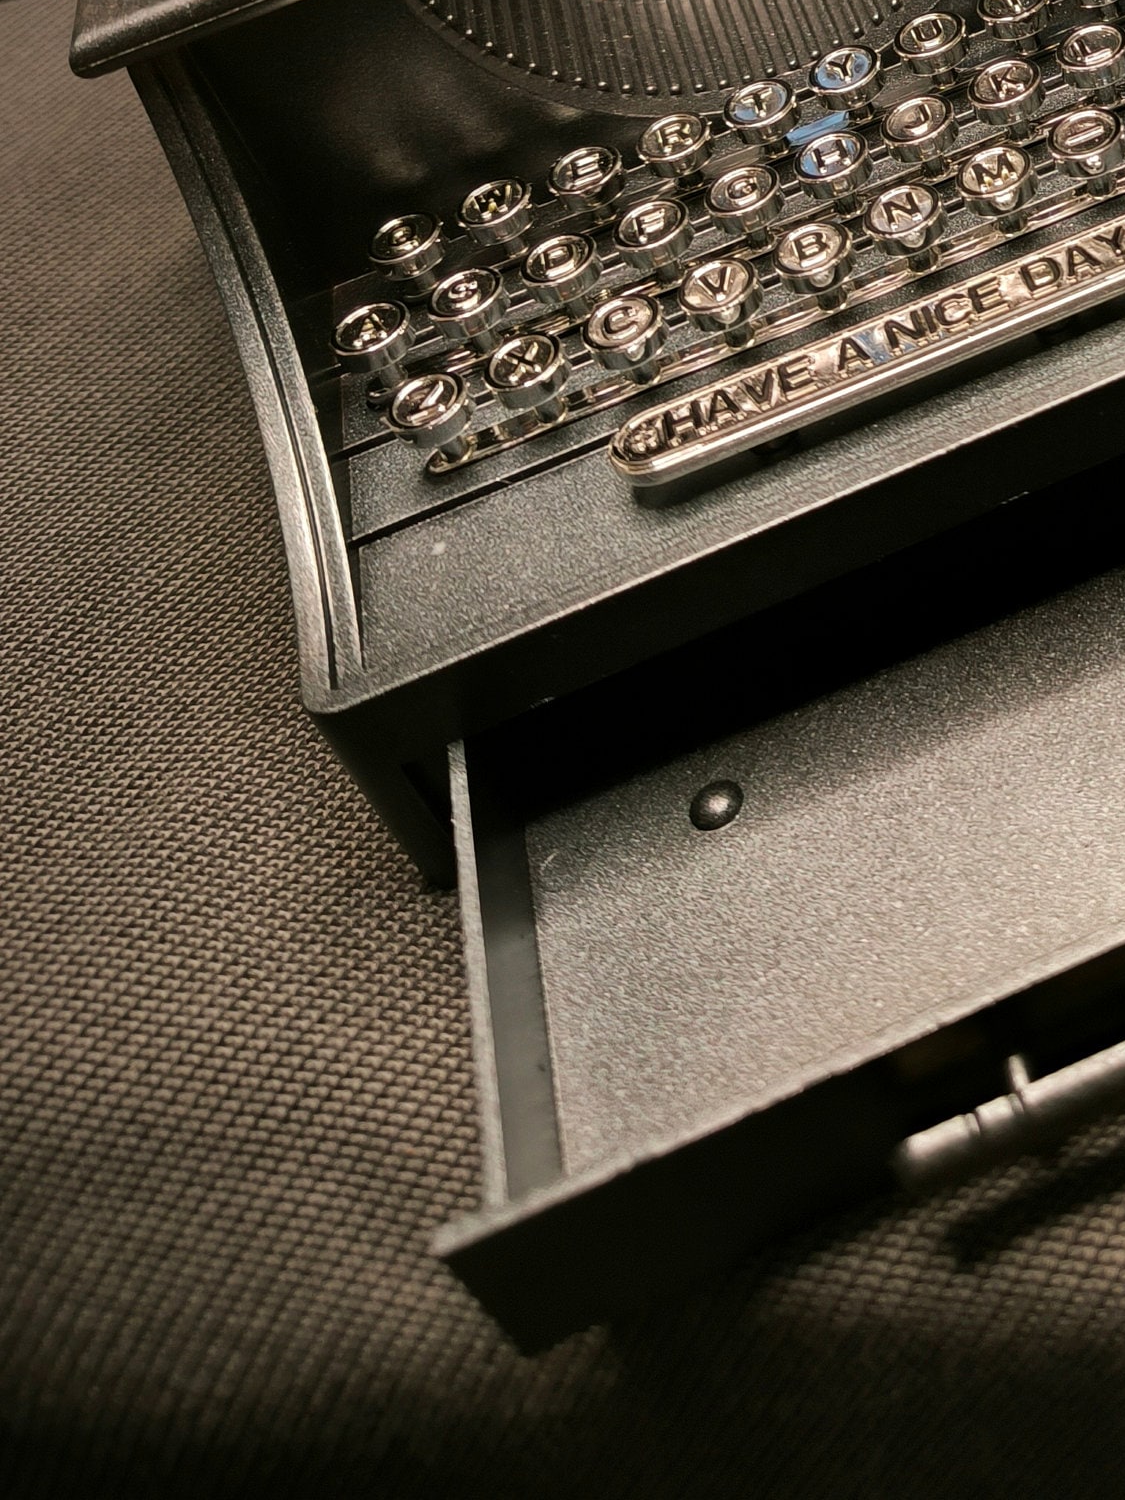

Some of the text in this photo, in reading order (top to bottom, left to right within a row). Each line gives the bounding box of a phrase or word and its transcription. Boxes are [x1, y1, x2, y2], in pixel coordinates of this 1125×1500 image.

[660, 352, 817, 451] HAVE
[836, 335, 876, 375] A
[883, 280, 1013, 358] NICE
